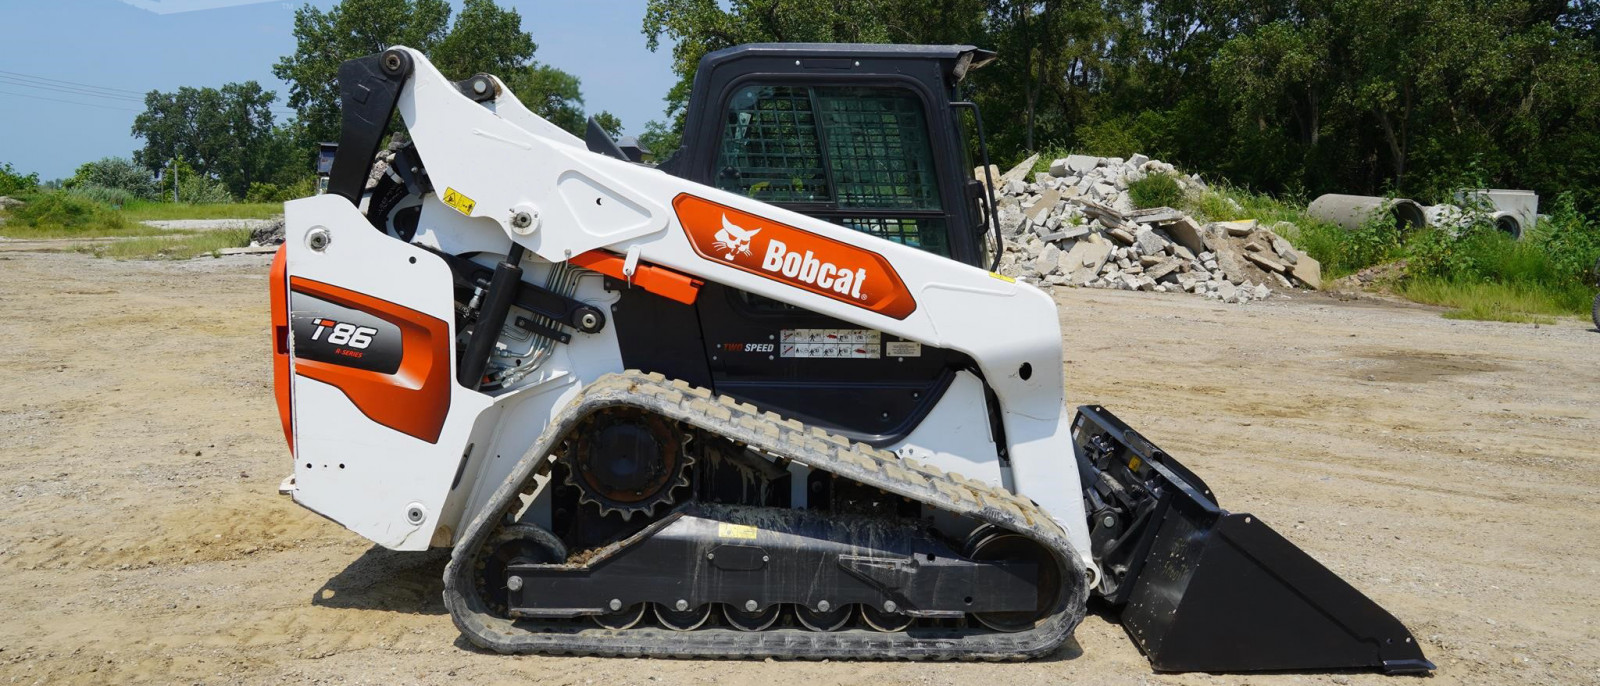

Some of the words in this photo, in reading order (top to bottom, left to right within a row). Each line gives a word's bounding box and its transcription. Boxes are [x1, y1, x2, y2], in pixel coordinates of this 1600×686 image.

[762, 239, 866, 298] Bobcat
[311, 318, 377, 349] T86
[724, 343, 743, 351] TWO
[744, 343, 774, 352] SPEED
